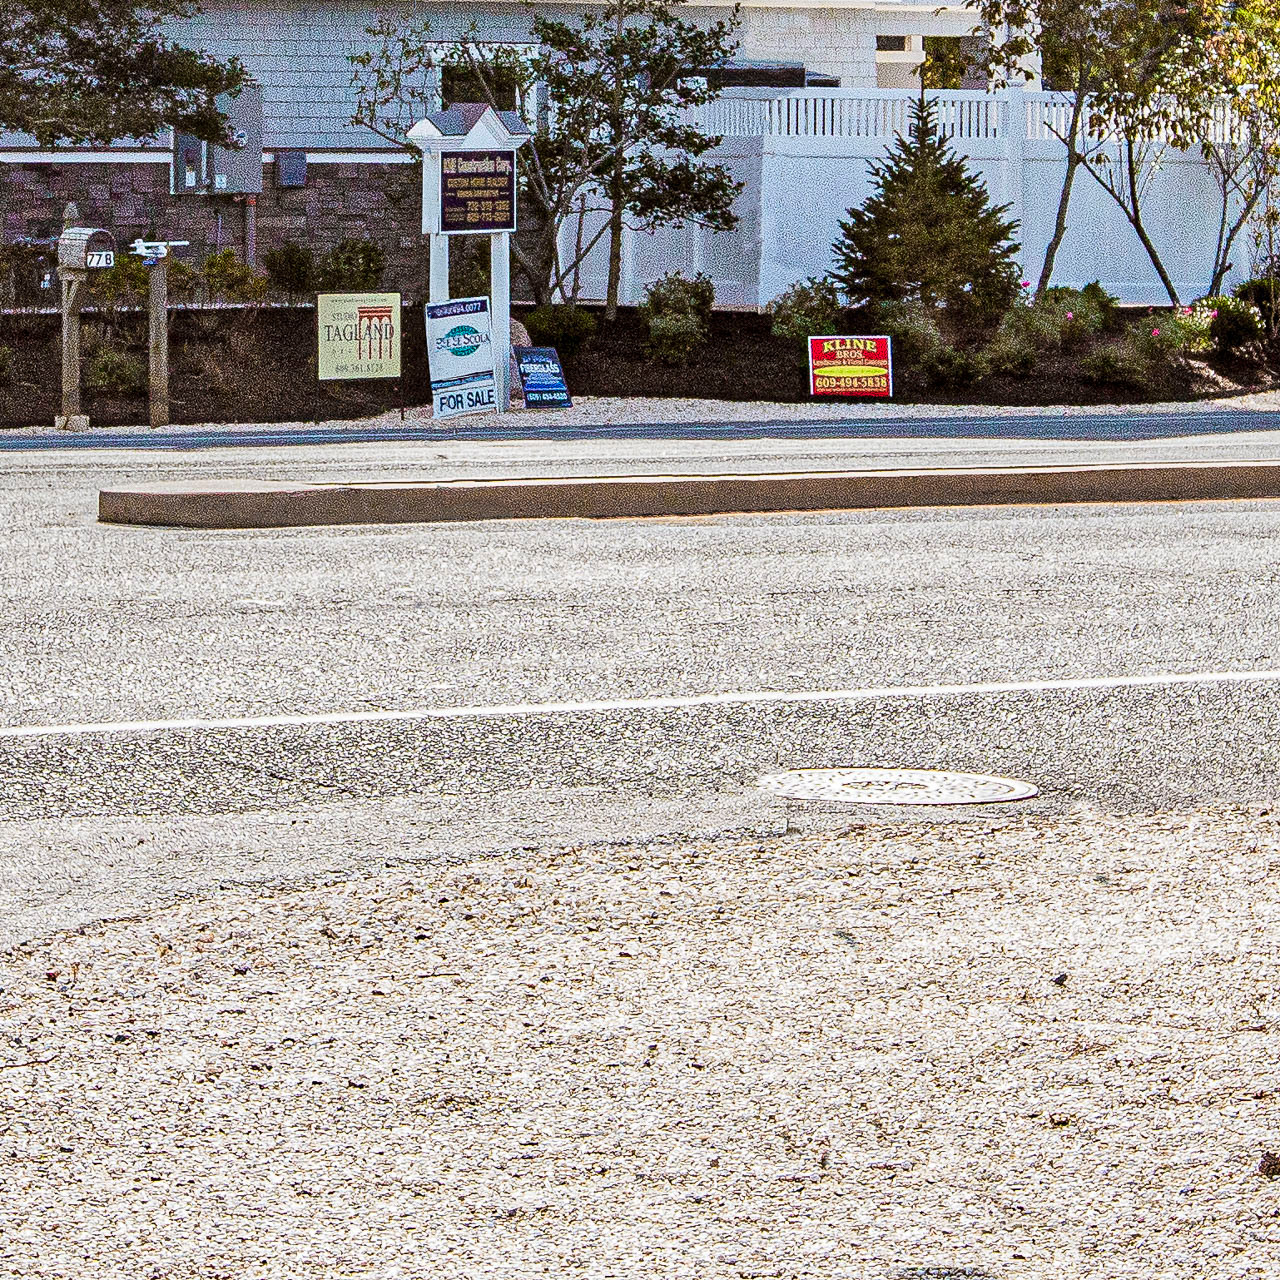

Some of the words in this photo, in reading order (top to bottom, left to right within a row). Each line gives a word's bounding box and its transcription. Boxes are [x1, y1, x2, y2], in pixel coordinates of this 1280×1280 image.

[324, 323, 395, 341] TAGLAND
[823, 338, 877, 353] KLINE
[836, 350, 865, 359] BROS.
[815, 376, 888, 388] 609-494-5838
[440, 394, 464, 411] FOR
[466, 389, 496, 408] SALE
